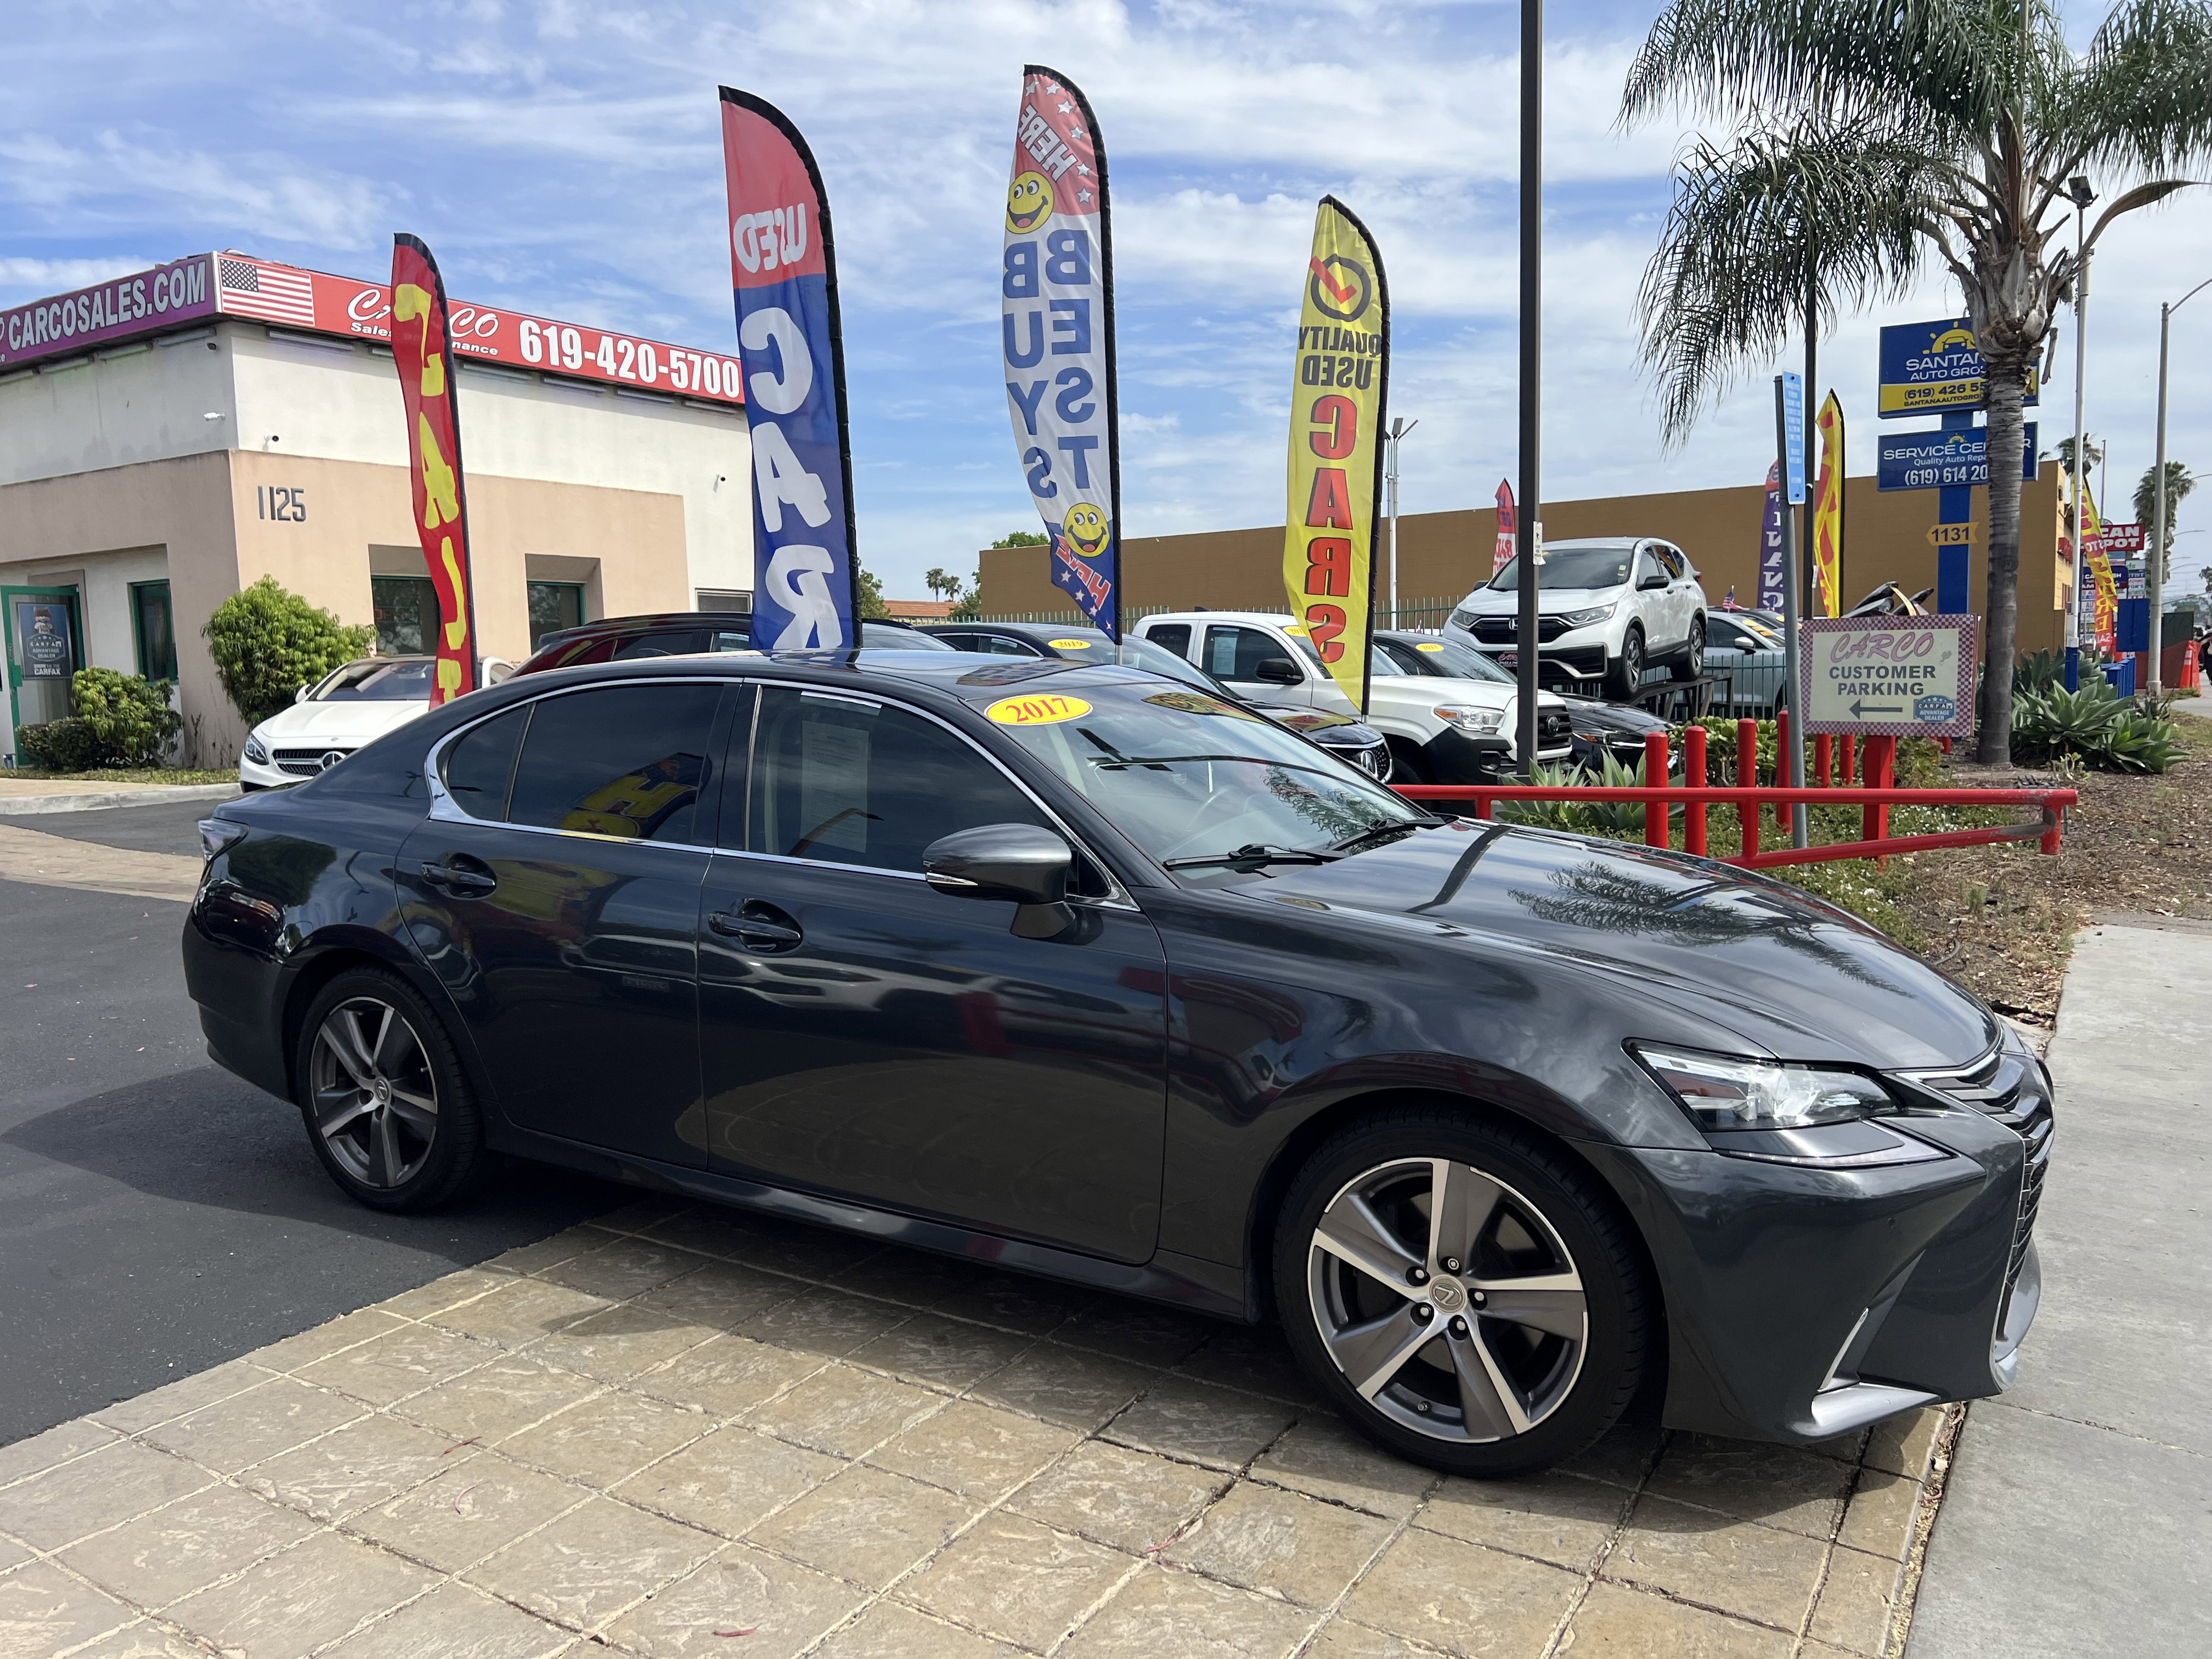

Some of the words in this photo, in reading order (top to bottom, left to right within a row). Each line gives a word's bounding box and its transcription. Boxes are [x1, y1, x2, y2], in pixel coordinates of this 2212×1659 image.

[9, 261, 207, 351] CARCOSALES.COM
[347, 289, 499, 338] CCO
[518, 319, 741, 399] 619-420-5700
[452, 341, 499, 356] nance
[1906, 352, 1986, 371] SANTAN
[1910, 369, 1948, 381] AUTO
[1904, 387, 1935, 400] (619)
[1939, 385, 1966, 396] 426
[1883, 443, 1956, 460] SERVICE
[1914, 456, 1944, 466] Quality
[1967, 454, 1987, 462] Repa
[1904, 468, 1939, 486] (619)
[1943, 466, 1967, 483] 614
[1971, 464, 1989, 481] 20
[258, 486, 307, 522] 1125
[1931, 527, 1970, 542] 1131
[1830, 632, 1934, 663] CARCO
[1830, 665, 1936, 679] CUSTOMER
[1838, 682, 1924, 696] PARKING
[1006, 698, 1071, 723] 2017
